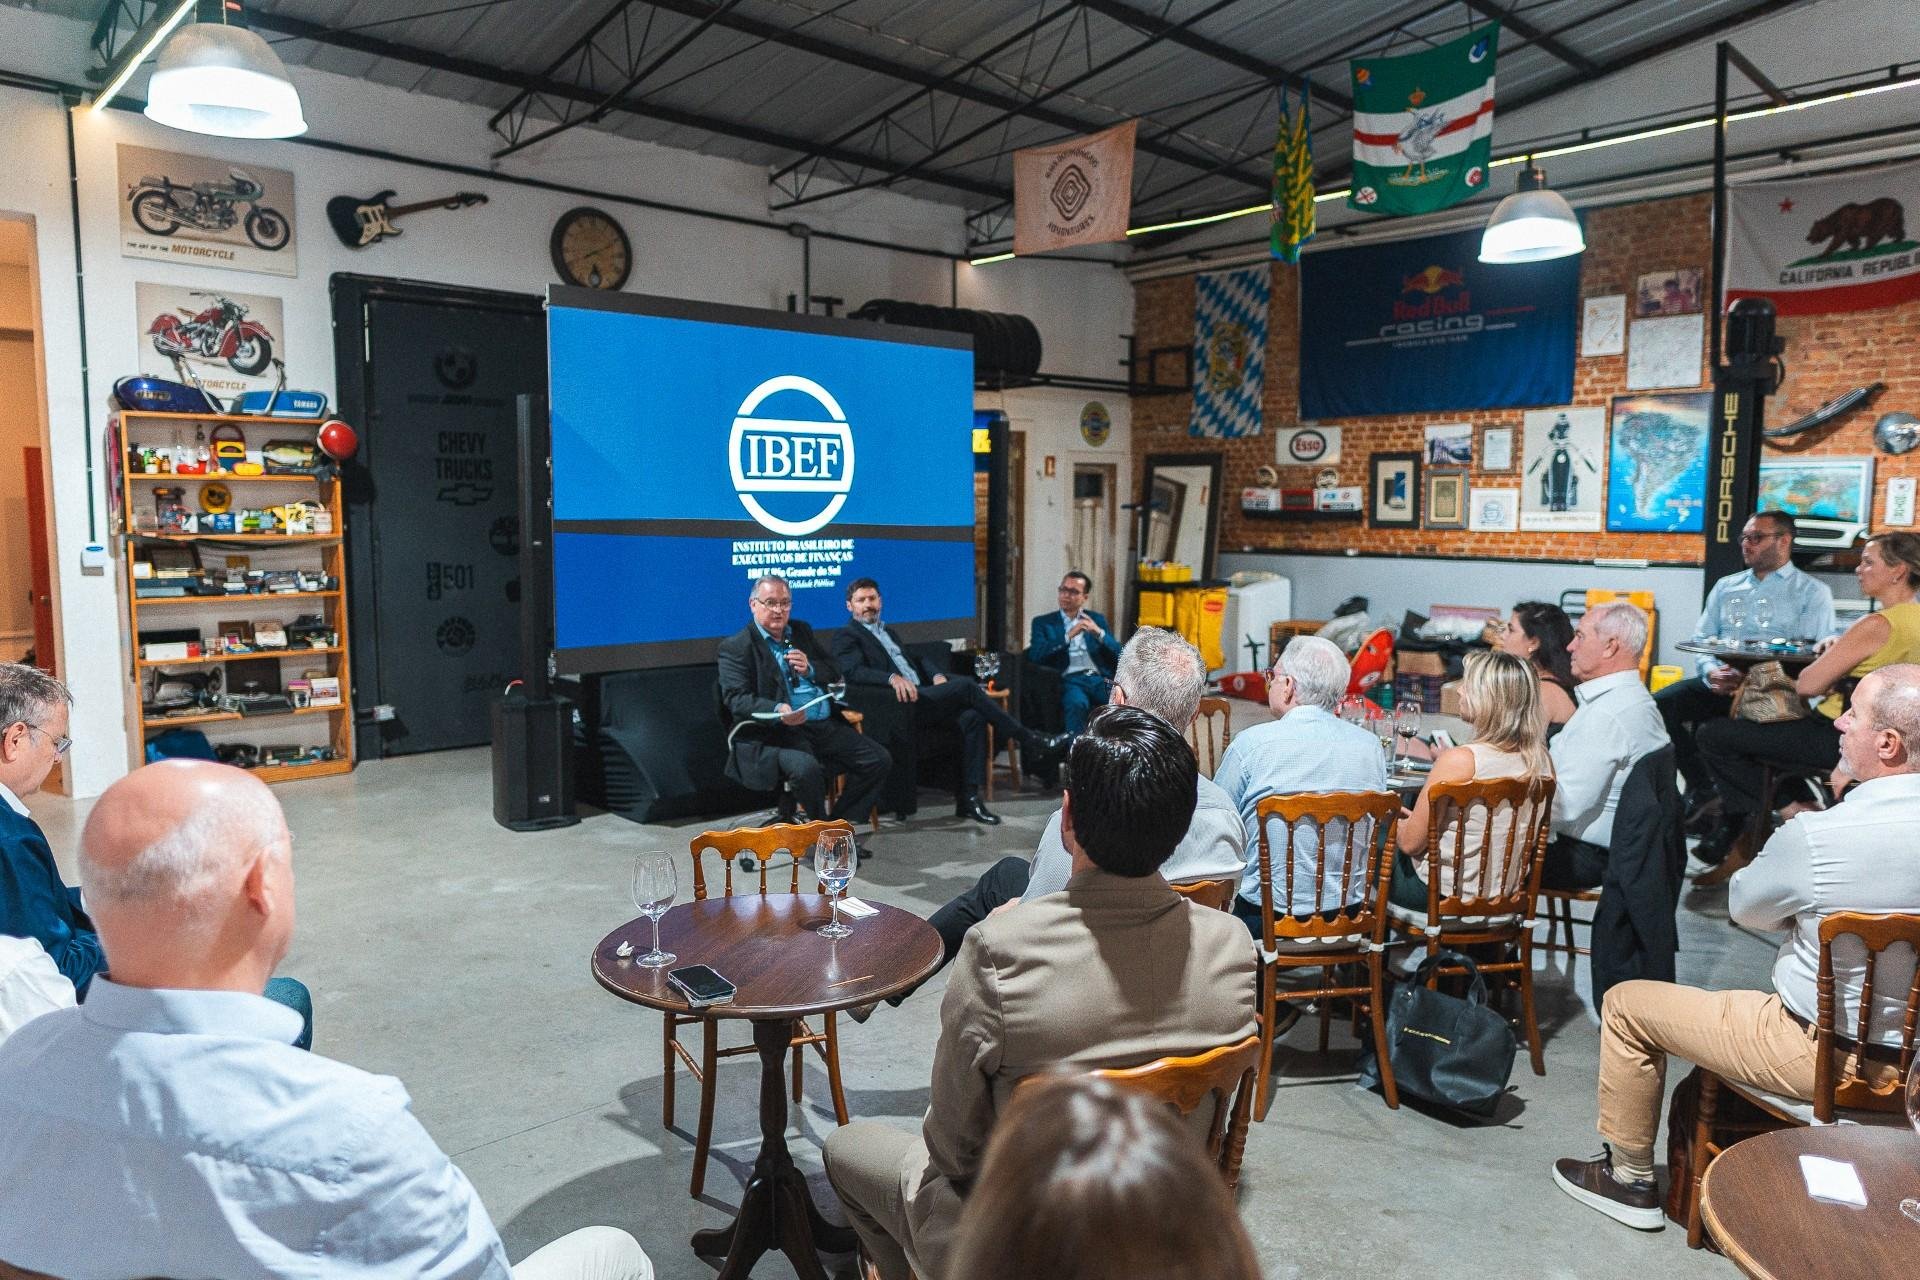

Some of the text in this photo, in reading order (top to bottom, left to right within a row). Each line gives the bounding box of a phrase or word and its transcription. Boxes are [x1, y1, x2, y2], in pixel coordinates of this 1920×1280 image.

[171, 243, 235, 261] MOTORCYCLE
[1779, 265, 1853, 286] CALIFORNIA
[1392, 291, 1470, 320] Red Bull
[1379, 314, 1484, 337] racing
[185, 378, 247, 390] MTORCYCLE
[438, 431, 486, 454] CHEVY
[745, 434, 841, 478] IBEF
[435, 458, 493, 480] TRUCKS
[1717, 392, 1739, 543] PORSCHE
[732, 538, 855, 553] INSTITUTO BRASILEIRO DE
[732, 551, 854, 566] EXECUTIVOS DE FINANÇAS
[443, 564, 475, 590] 501
